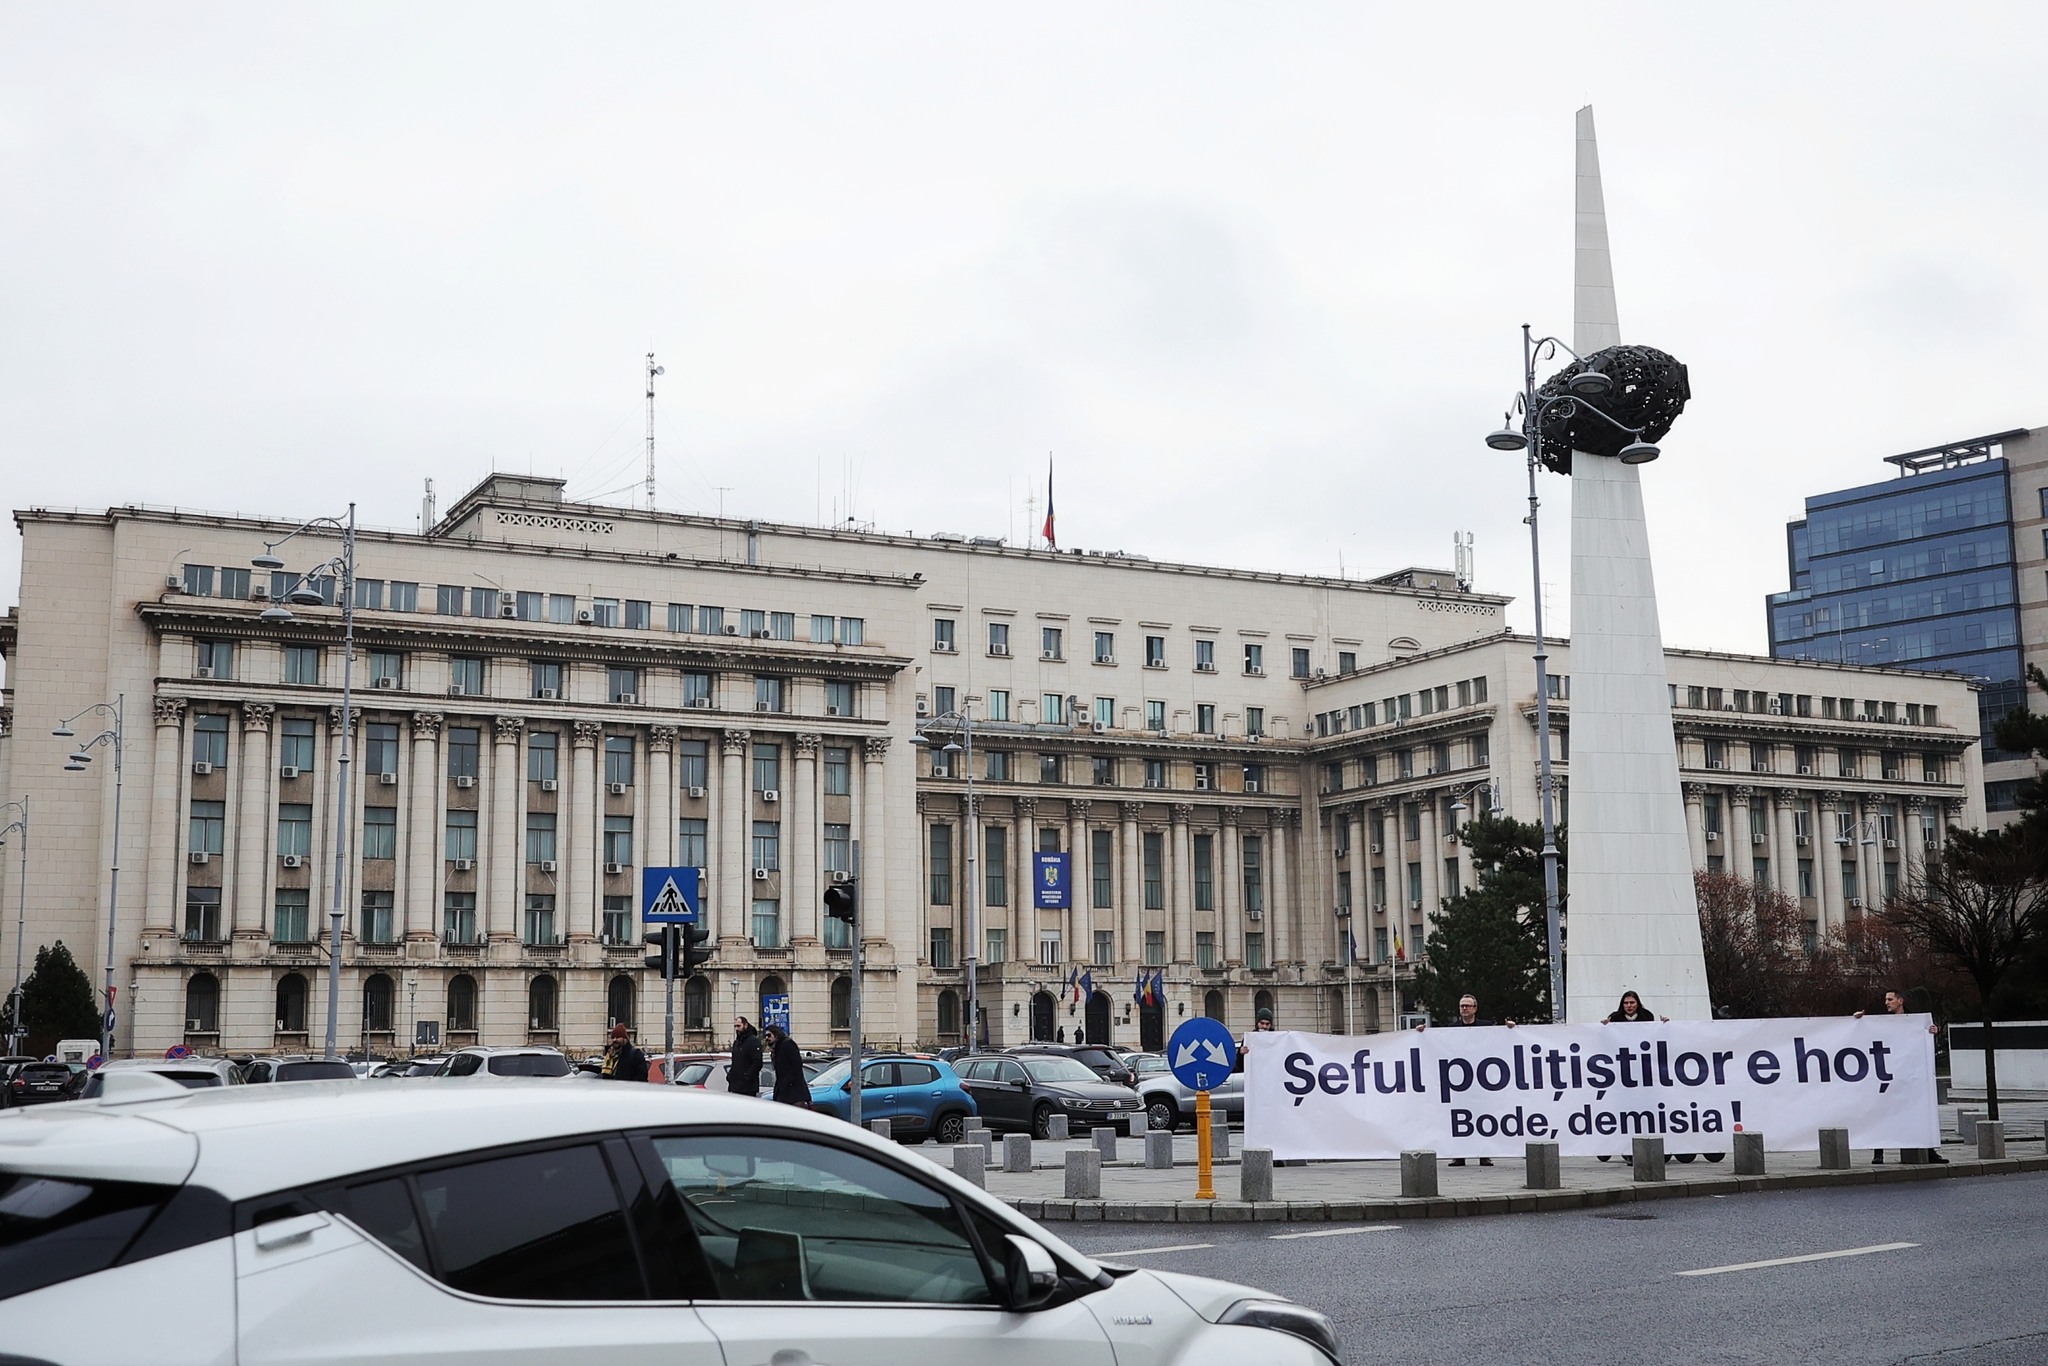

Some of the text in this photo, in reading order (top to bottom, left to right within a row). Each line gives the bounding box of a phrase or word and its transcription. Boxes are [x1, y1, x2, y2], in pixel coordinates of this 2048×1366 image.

[1283, 1036, 1894, 1107] Șeful polițiștilor e hoț
[1450, 1105, 1559, 1140] Bode,
